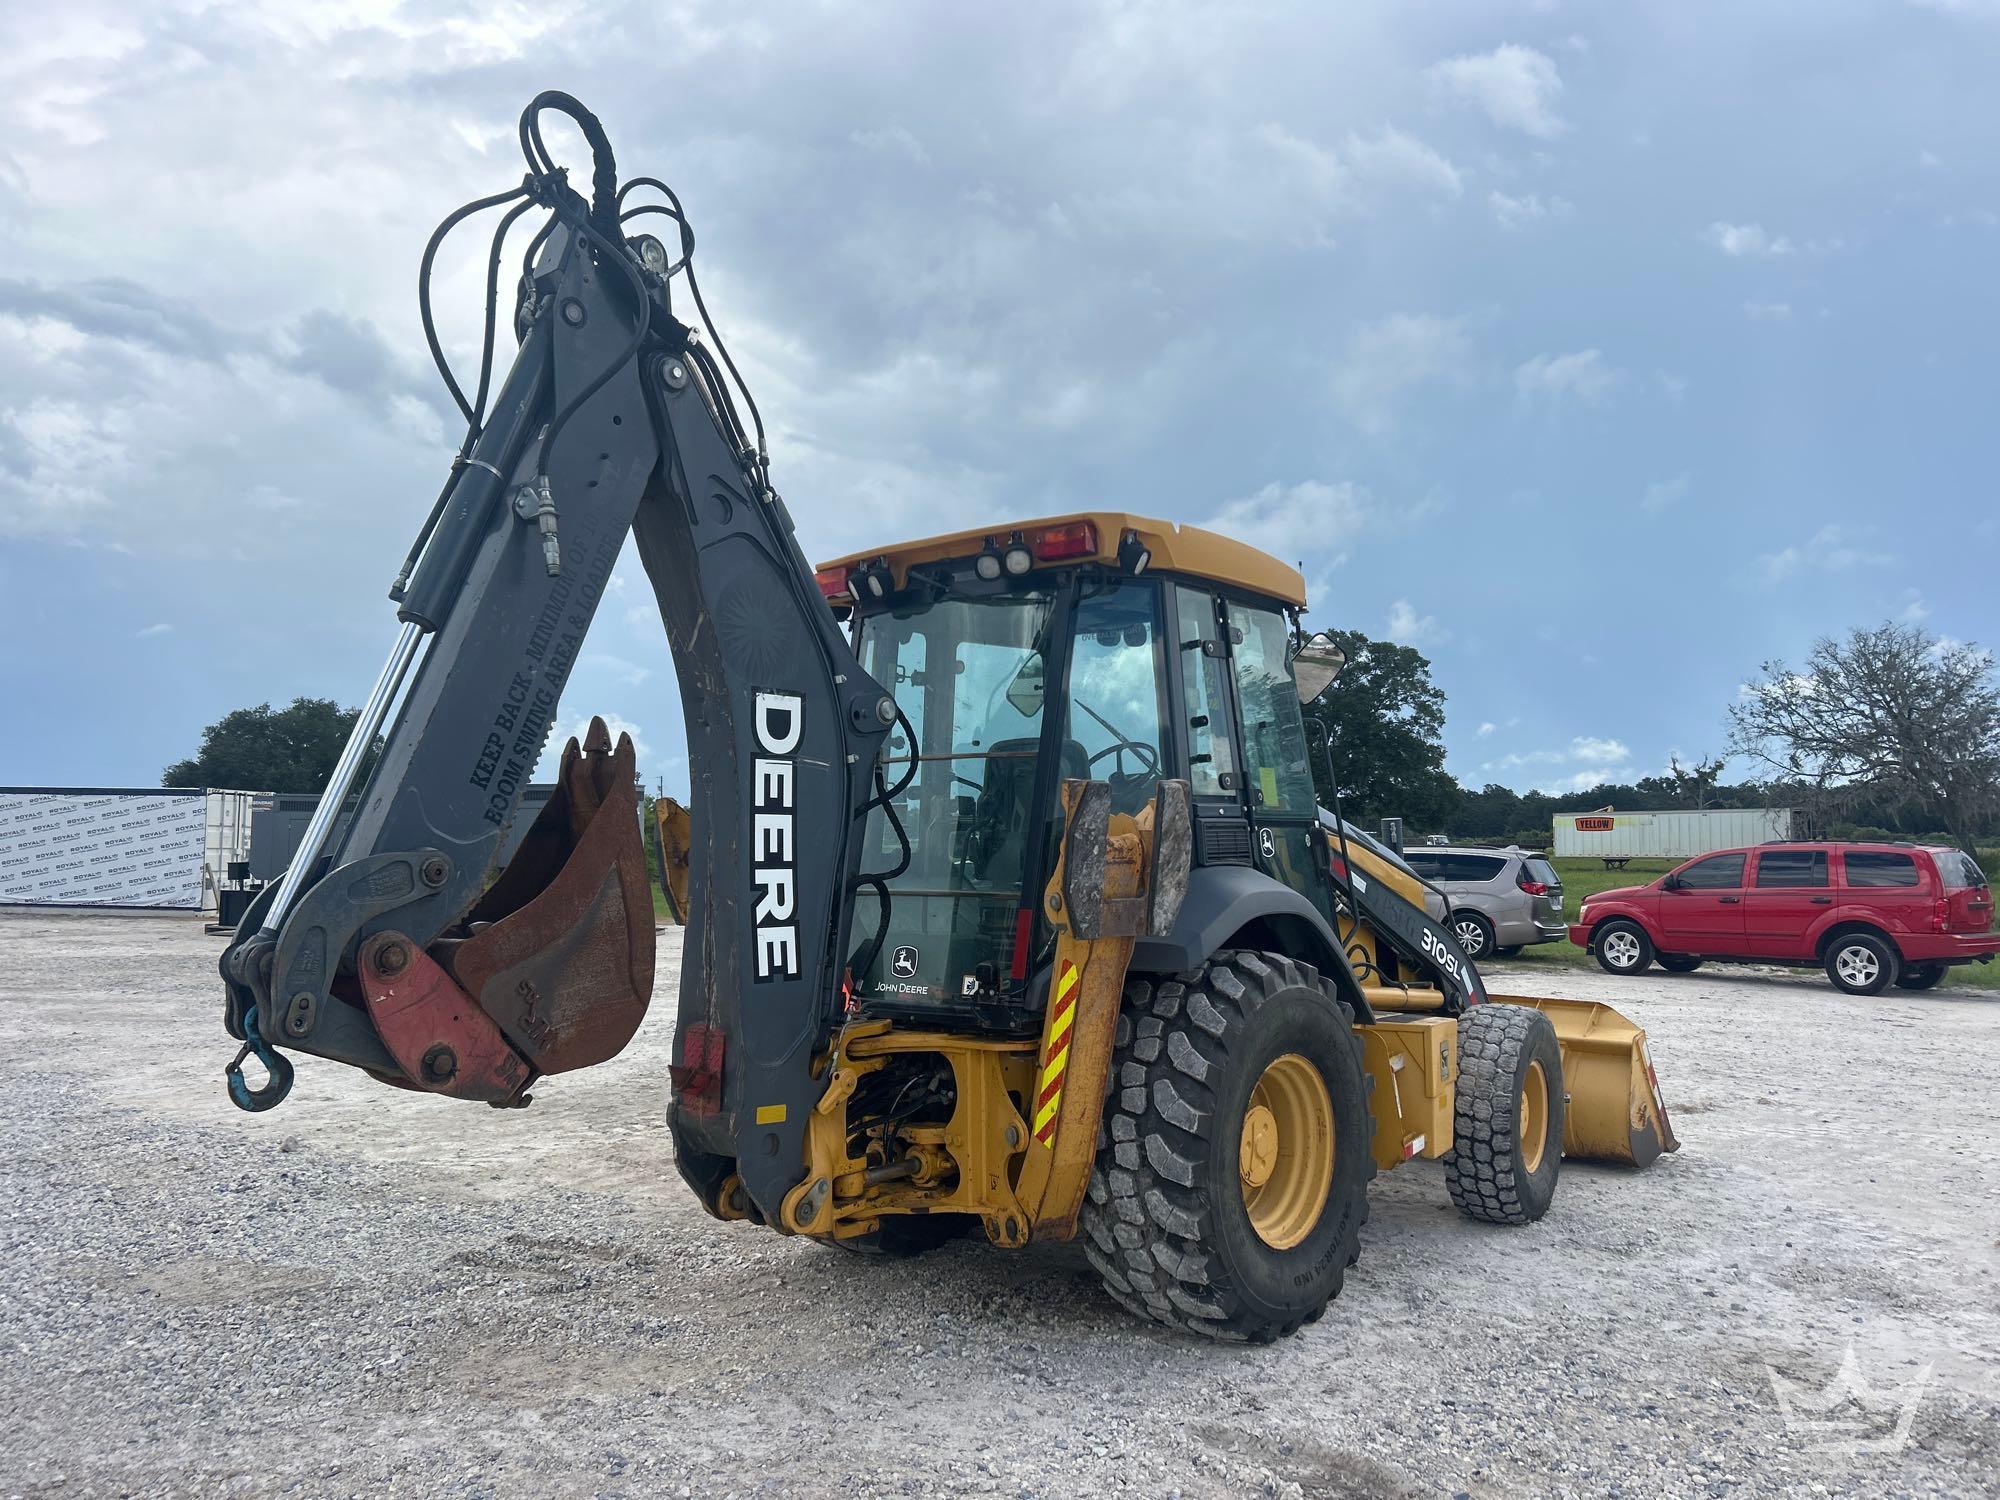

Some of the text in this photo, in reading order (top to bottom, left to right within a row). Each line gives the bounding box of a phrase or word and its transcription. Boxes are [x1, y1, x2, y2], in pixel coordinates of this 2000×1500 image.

[470, 732, 505, 791] KEEP
[495, 672, 533, 733] BACK
[525, 564, 577, 661] MINIMUM
[568, 535, 588, 566] OF
[484, 759, 524, 826] BOOM
[513, 688, 554, 760] SWING
[544, 632, 580, 689] AREA
[568, 615, 585, 630] &
[580, 533, 618, 615] LOADER
[754, 692, 801, 977] DEERE
[1580, 820, 1609, 828] YELLOW
[875, 982, 928, 995] JOHN DEERE
[1421, 928, 1460, 980] 310SL
